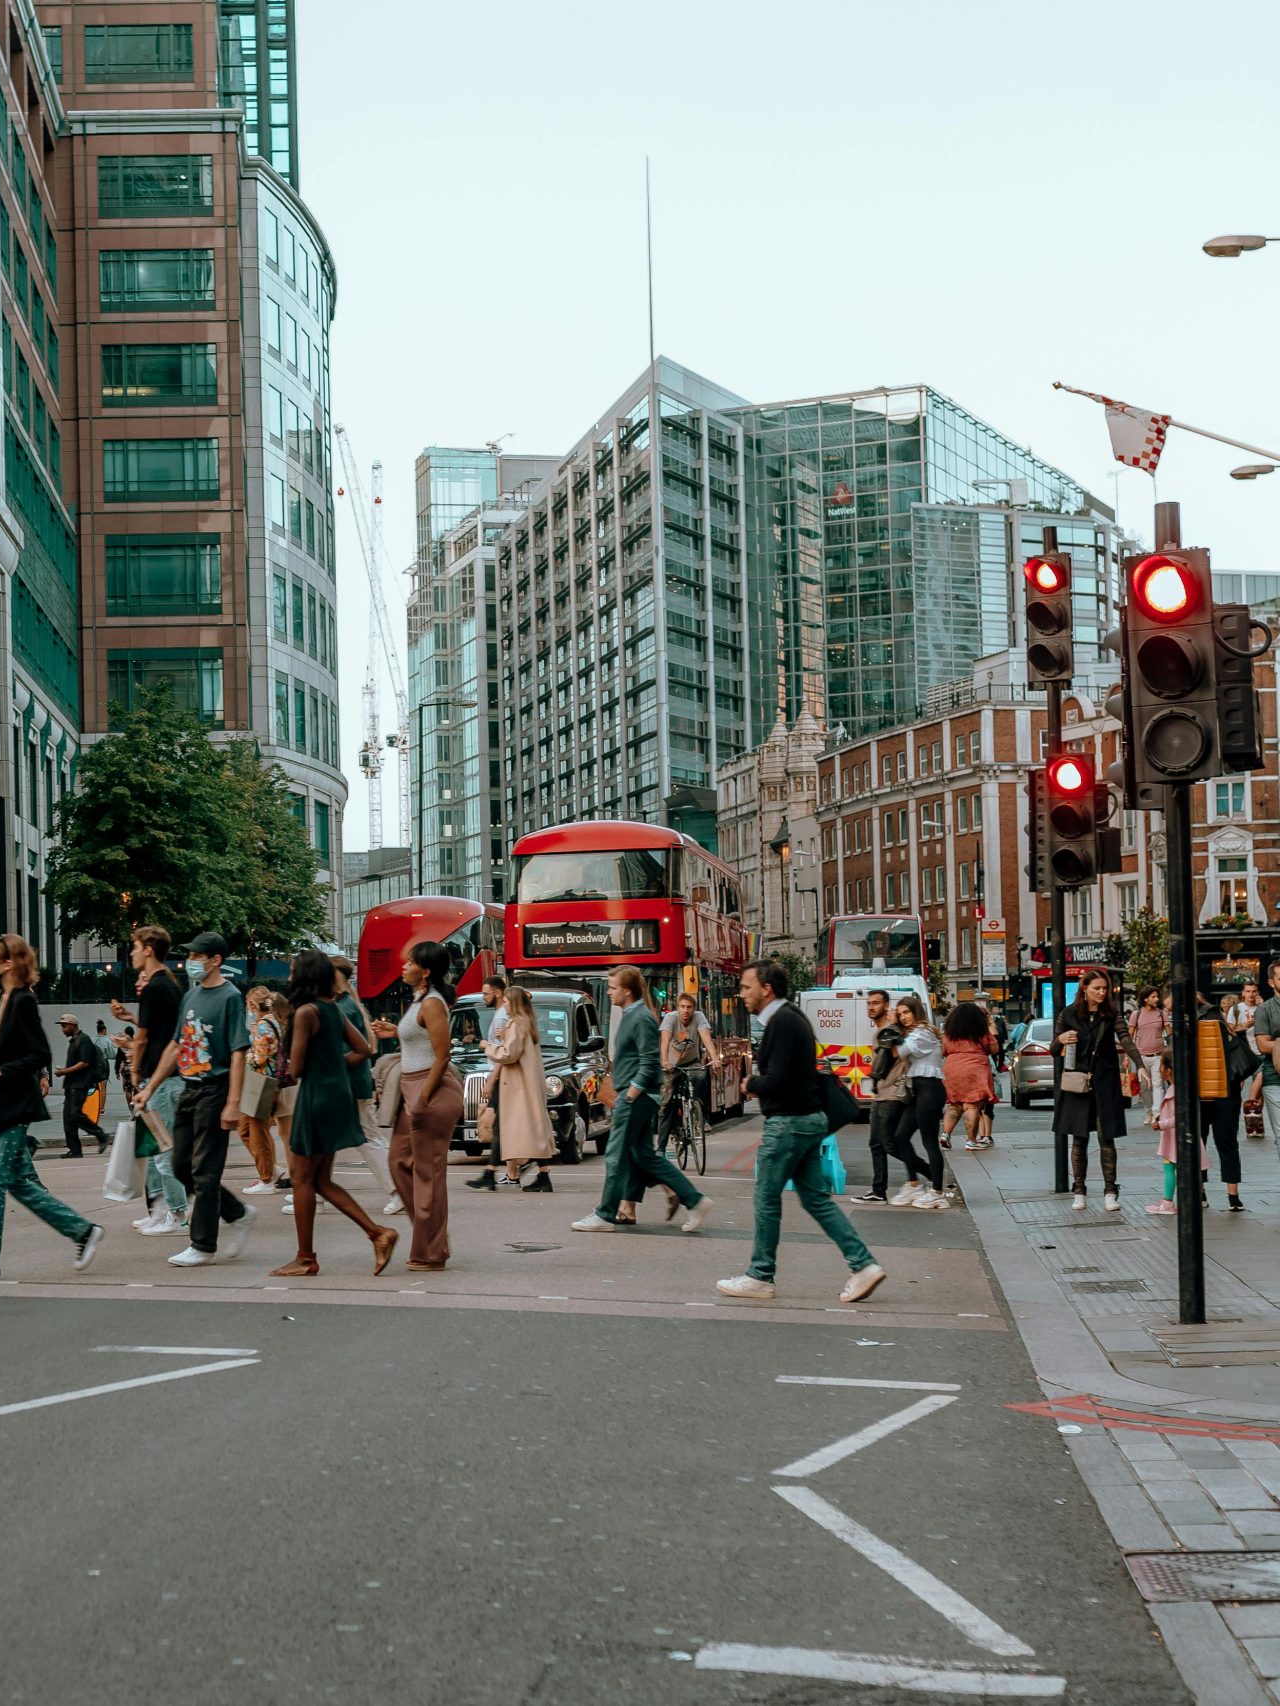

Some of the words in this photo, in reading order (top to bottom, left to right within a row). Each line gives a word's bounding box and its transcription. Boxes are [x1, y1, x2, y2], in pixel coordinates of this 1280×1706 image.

[828, 507, 856, 516] NatWest
[975, 908, 982, 918] L
[531, 933, 565, 945] Fulham
[566, 932, 609, 945] Broadway
[630, 927, 643, 948] 11
[1073, 945, 1106, 962] NatWest
[817, 1009, 844, 1018] POLICE
[819, 1020, 841, 1028] DOGS
